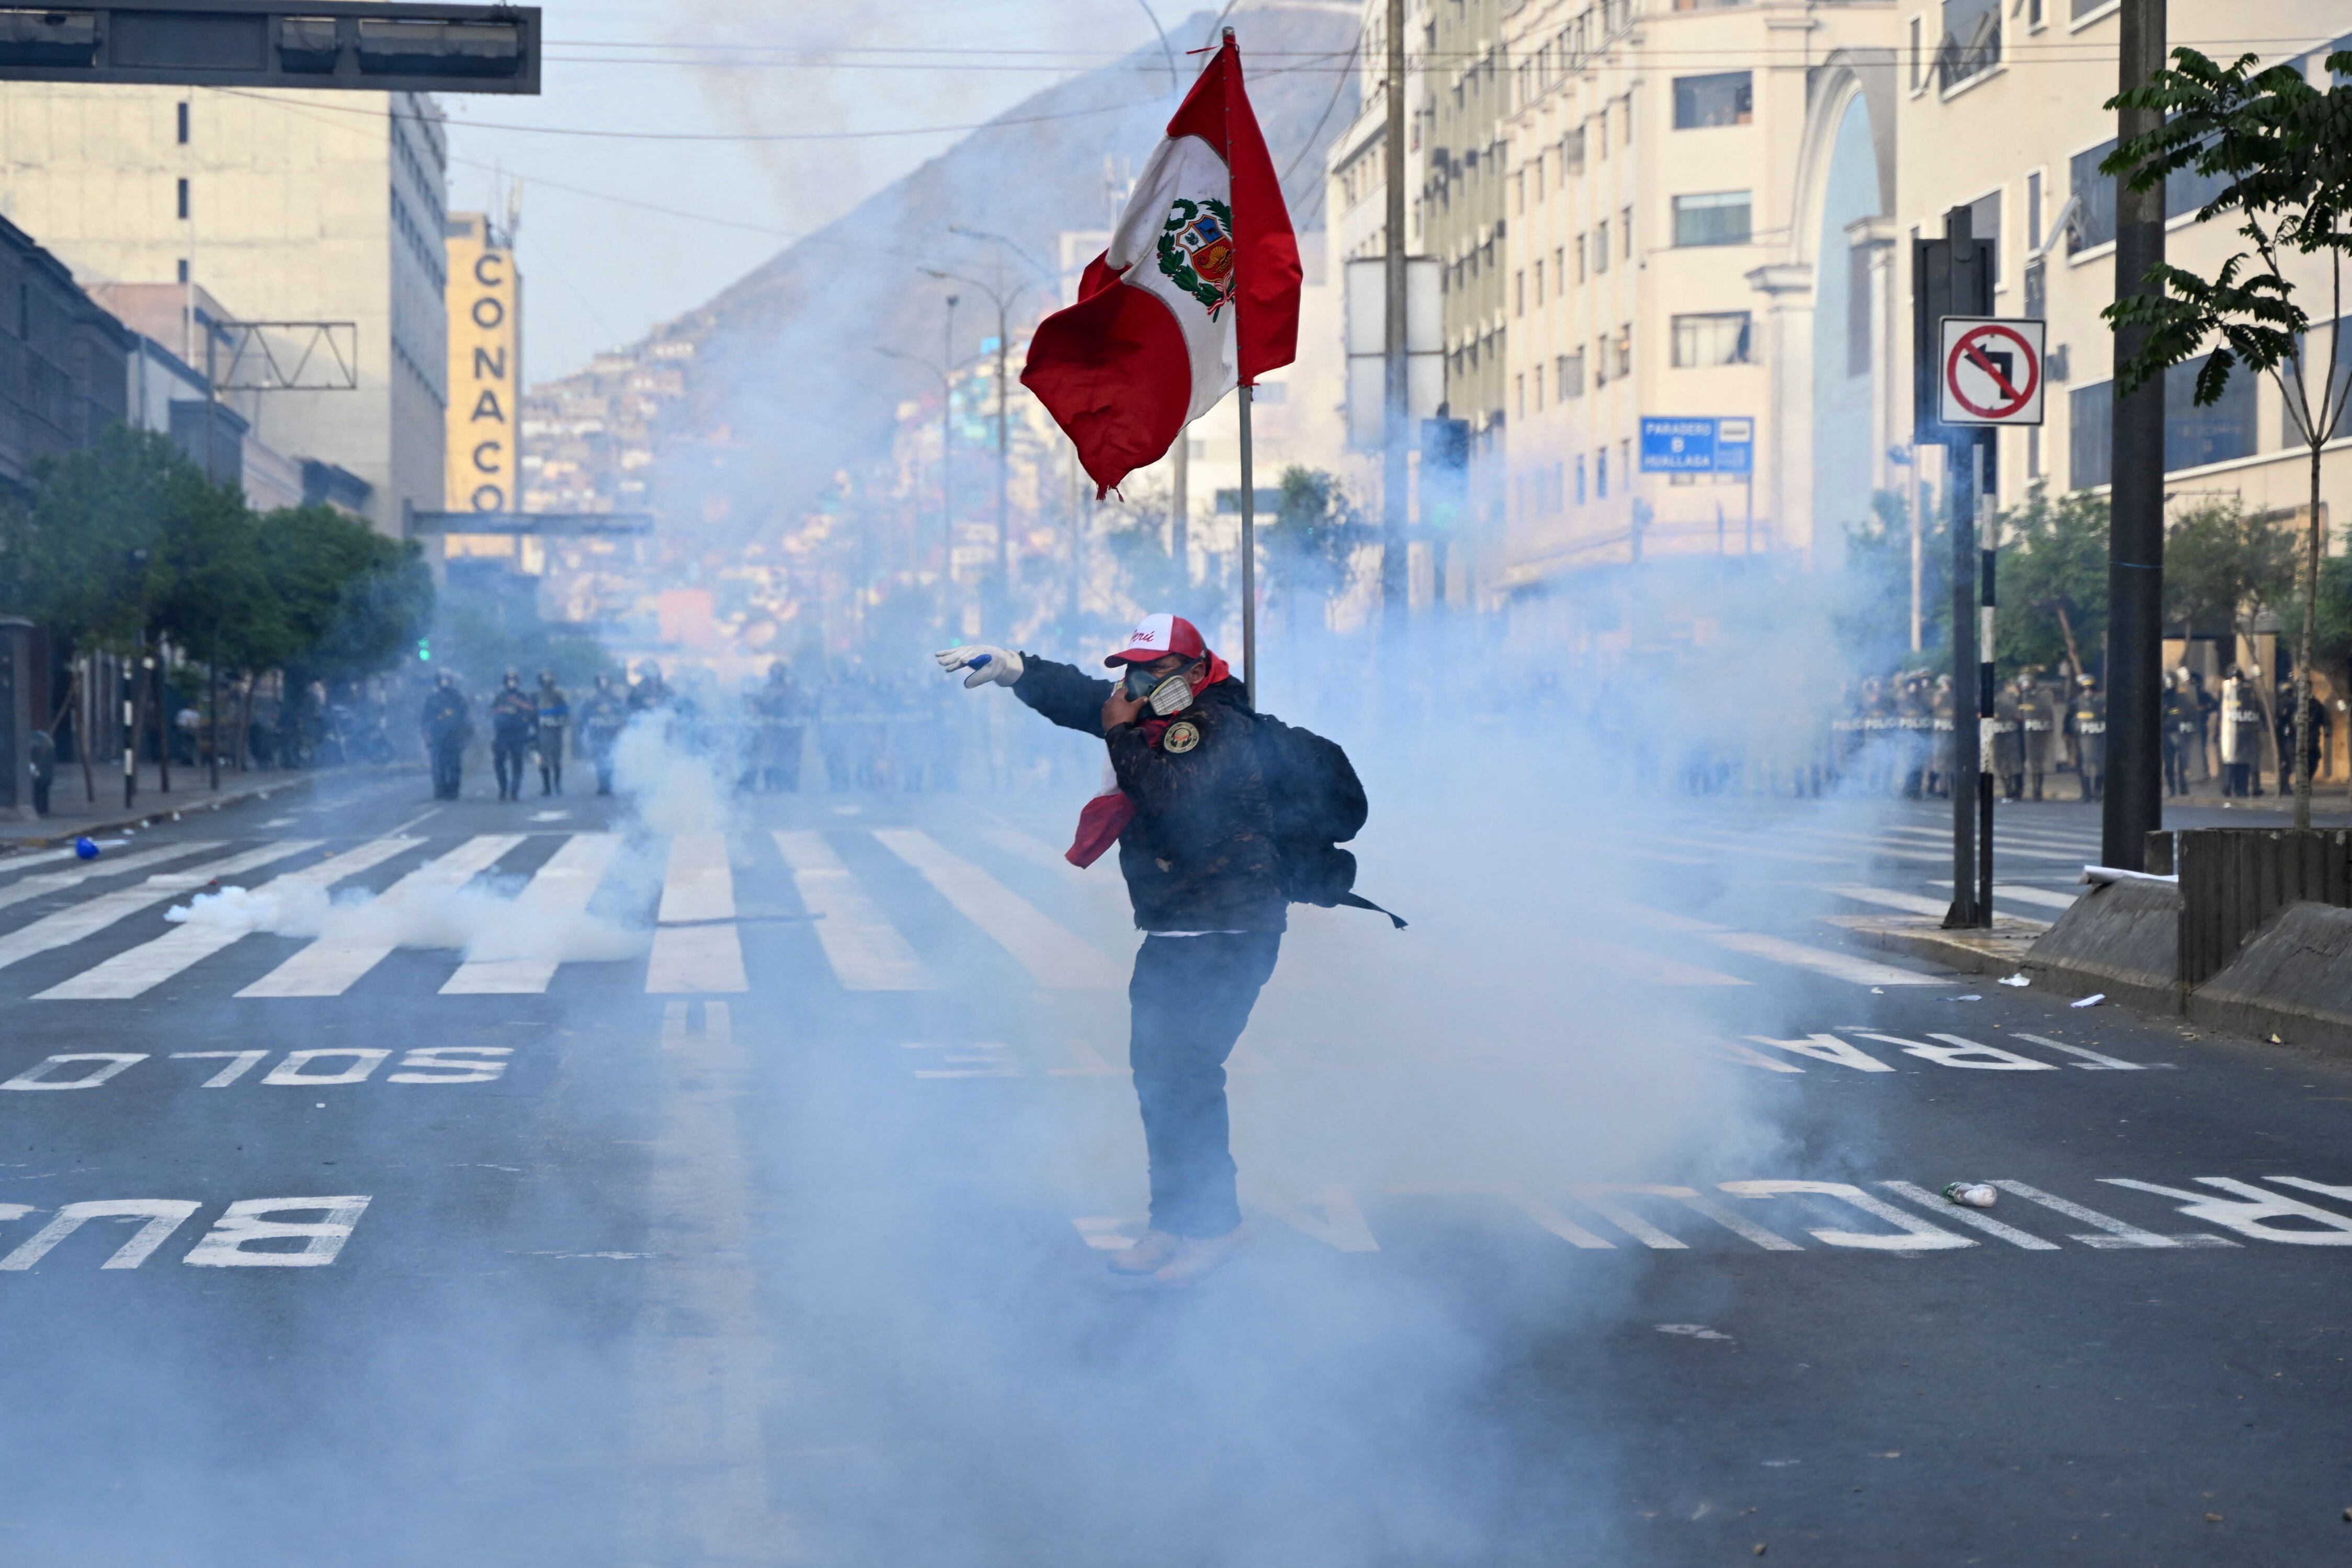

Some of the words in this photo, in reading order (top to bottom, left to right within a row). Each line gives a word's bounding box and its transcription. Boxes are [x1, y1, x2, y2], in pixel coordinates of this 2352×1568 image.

[472, 254, 505, 512] CONACO
[1645, 423, 1712, 436] PARADERO
[0, 1047, 515, 1091] SOLO
